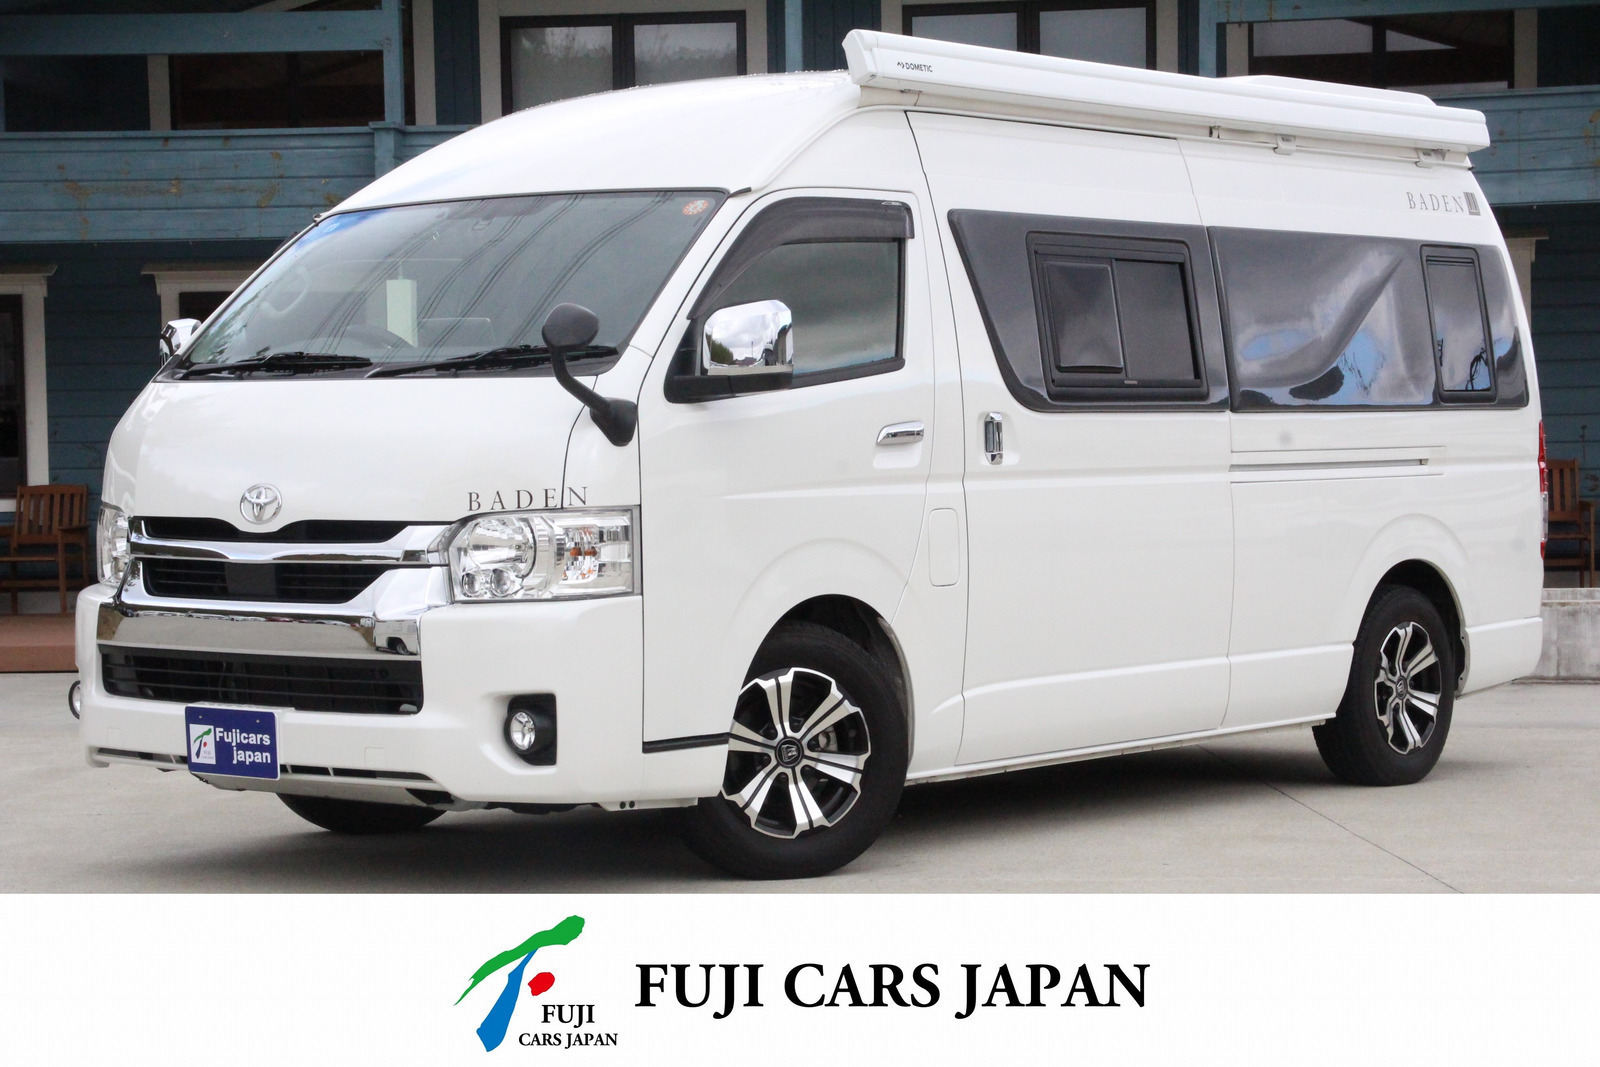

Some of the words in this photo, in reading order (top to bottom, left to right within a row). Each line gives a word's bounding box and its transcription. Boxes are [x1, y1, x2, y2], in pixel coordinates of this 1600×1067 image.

[905, 62, 933, 72] DOMETIC
[1406, 191, 1464, 213] BADEN
[467, 486, 588, 511] BADEN
[215, 727, 271, 746] Fujicars
[232, 746, 271, 765] japan
